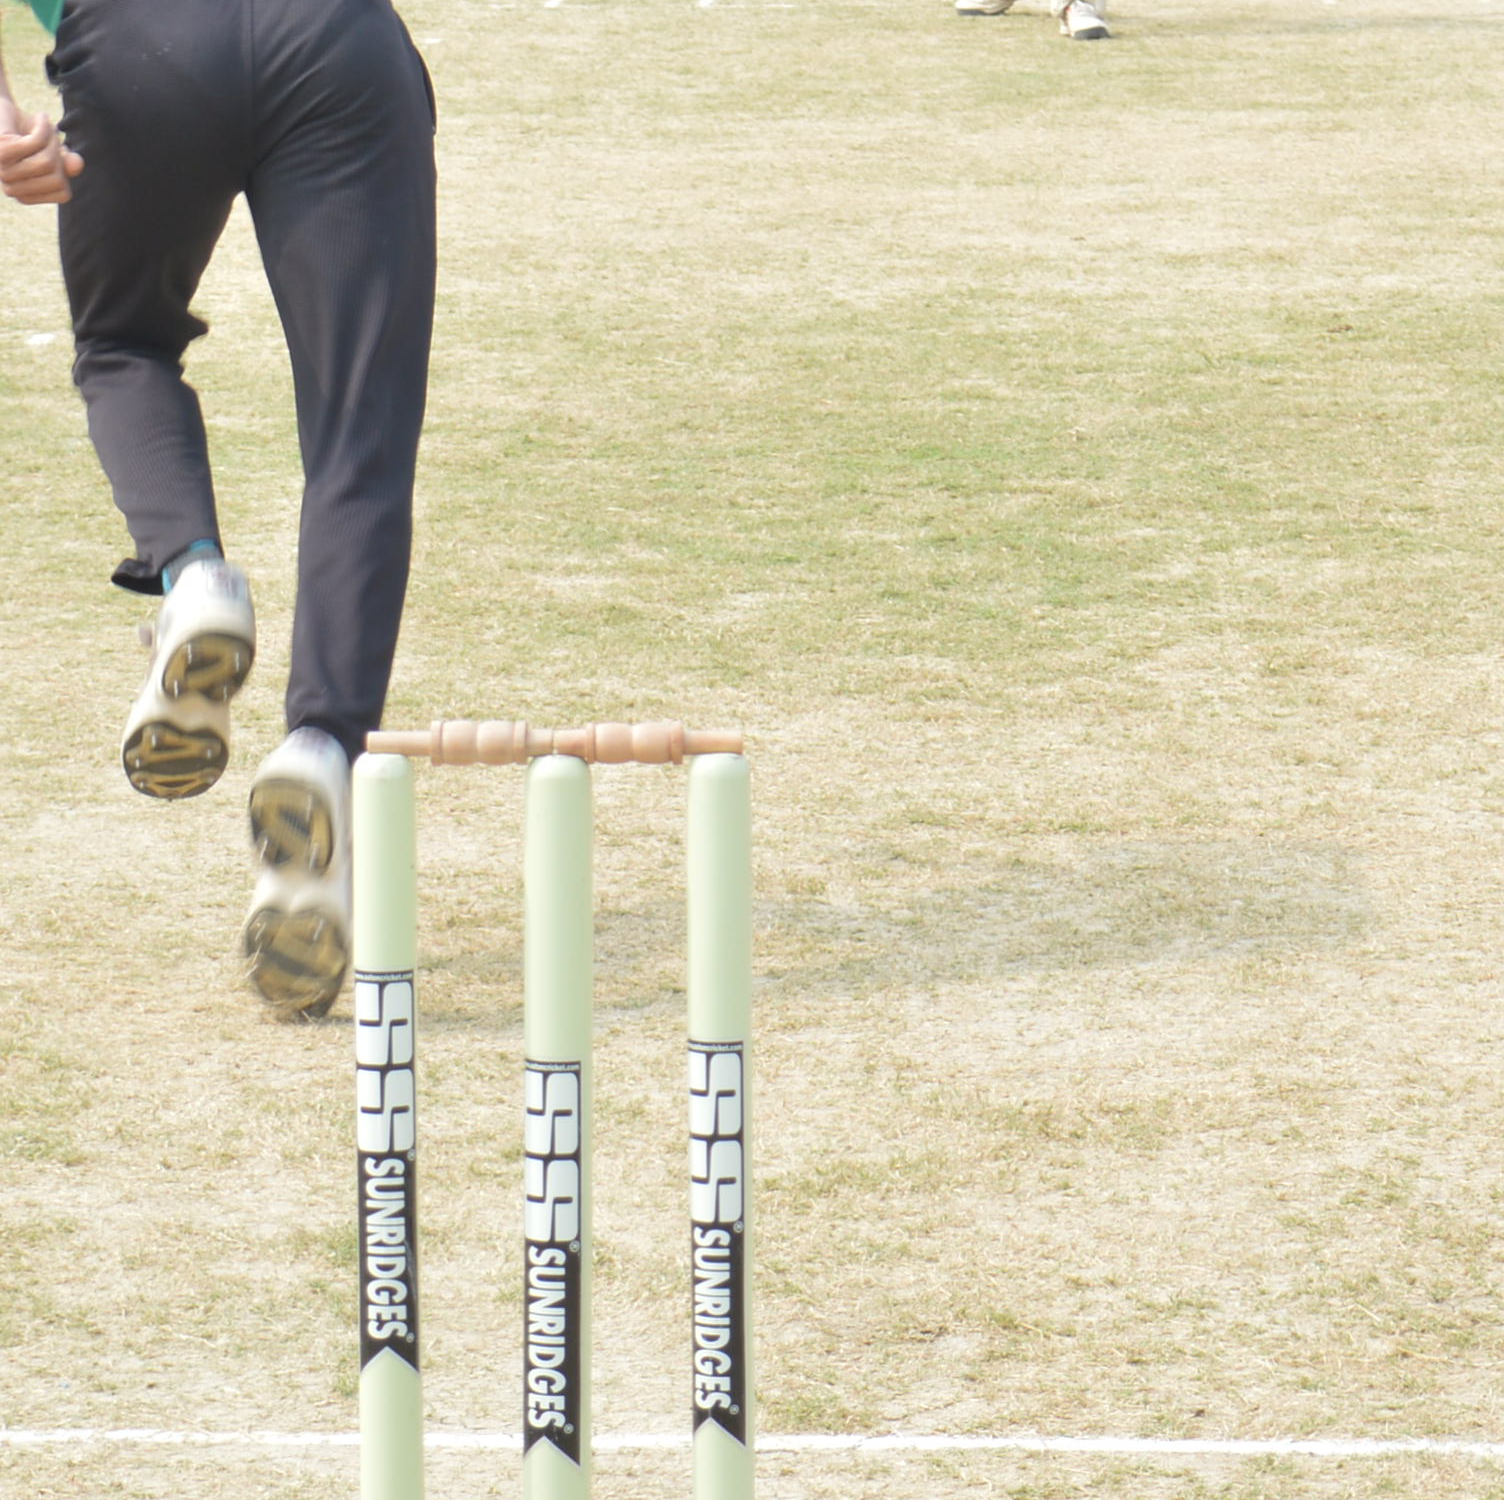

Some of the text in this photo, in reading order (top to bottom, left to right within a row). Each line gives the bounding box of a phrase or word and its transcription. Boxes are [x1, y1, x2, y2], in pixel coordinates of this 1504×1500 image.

[355, 981, 415, 1339] SS SUNRIDGES
[526, 1070, 579, 1428] SS SUNRIDGES
[688, 1052, 742, 1409] SS SUNRIDGES
